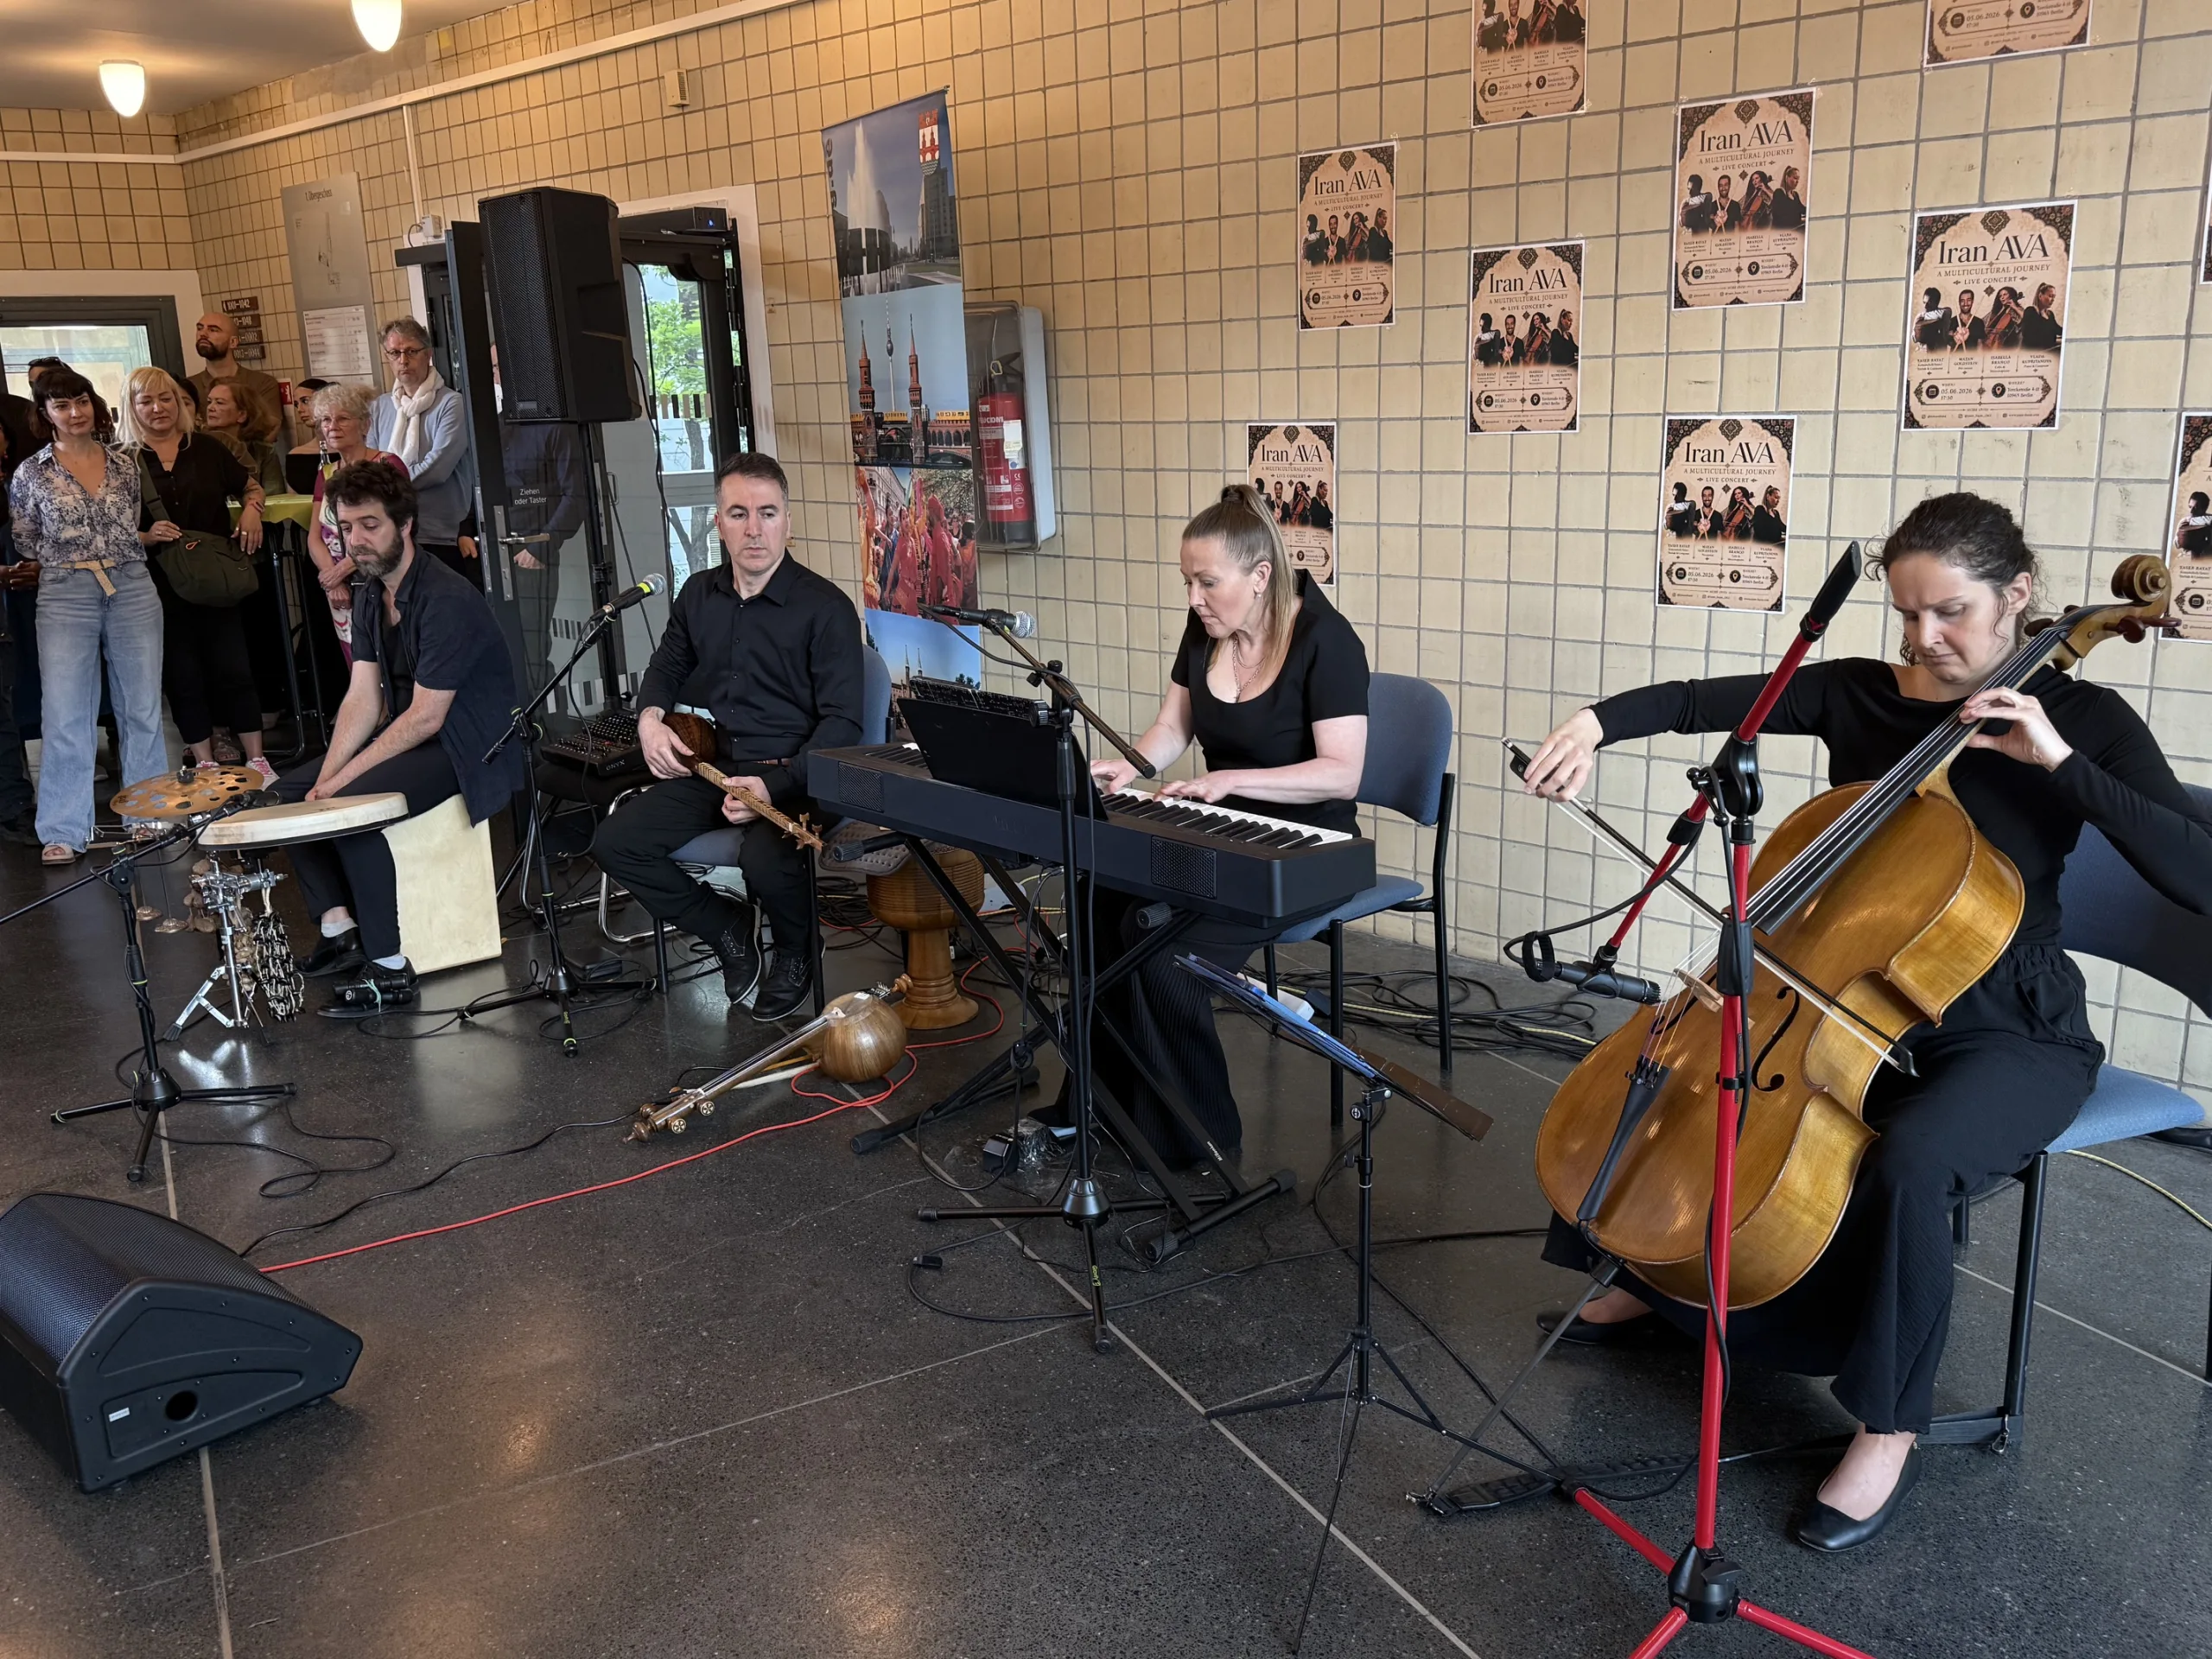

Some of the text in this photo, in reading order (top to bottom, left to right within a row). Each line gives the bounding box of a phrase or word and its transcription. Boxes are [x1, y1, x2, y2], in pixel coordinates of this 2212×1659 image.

[1700, 119, 1793, 152] Iran AVA
[1704, 151, 1761, 163] MULTICULTURAL
[1763, 148, 1794, 158] JOURNEY
[1737, 160, 1767, 168] CONCERT
[1314, 168, 1382, 195] Iran AVA
[1938, 233, 2049, 264] Iran AVA
[1943, 266, 2011, 276] MULTICULTURAL
[2012, 264, 2050, 274] JOURNEY
[1489, 268, 1567, 293] Iran AVA
[1493, 295, 1541, 303] MULTICULTURAL
[1541, 293, 1567, 302] JOURNEY
[1262, 444, 1323, 462] Iran AVA
[1685, 442, 1775, 463] Iran AVA
